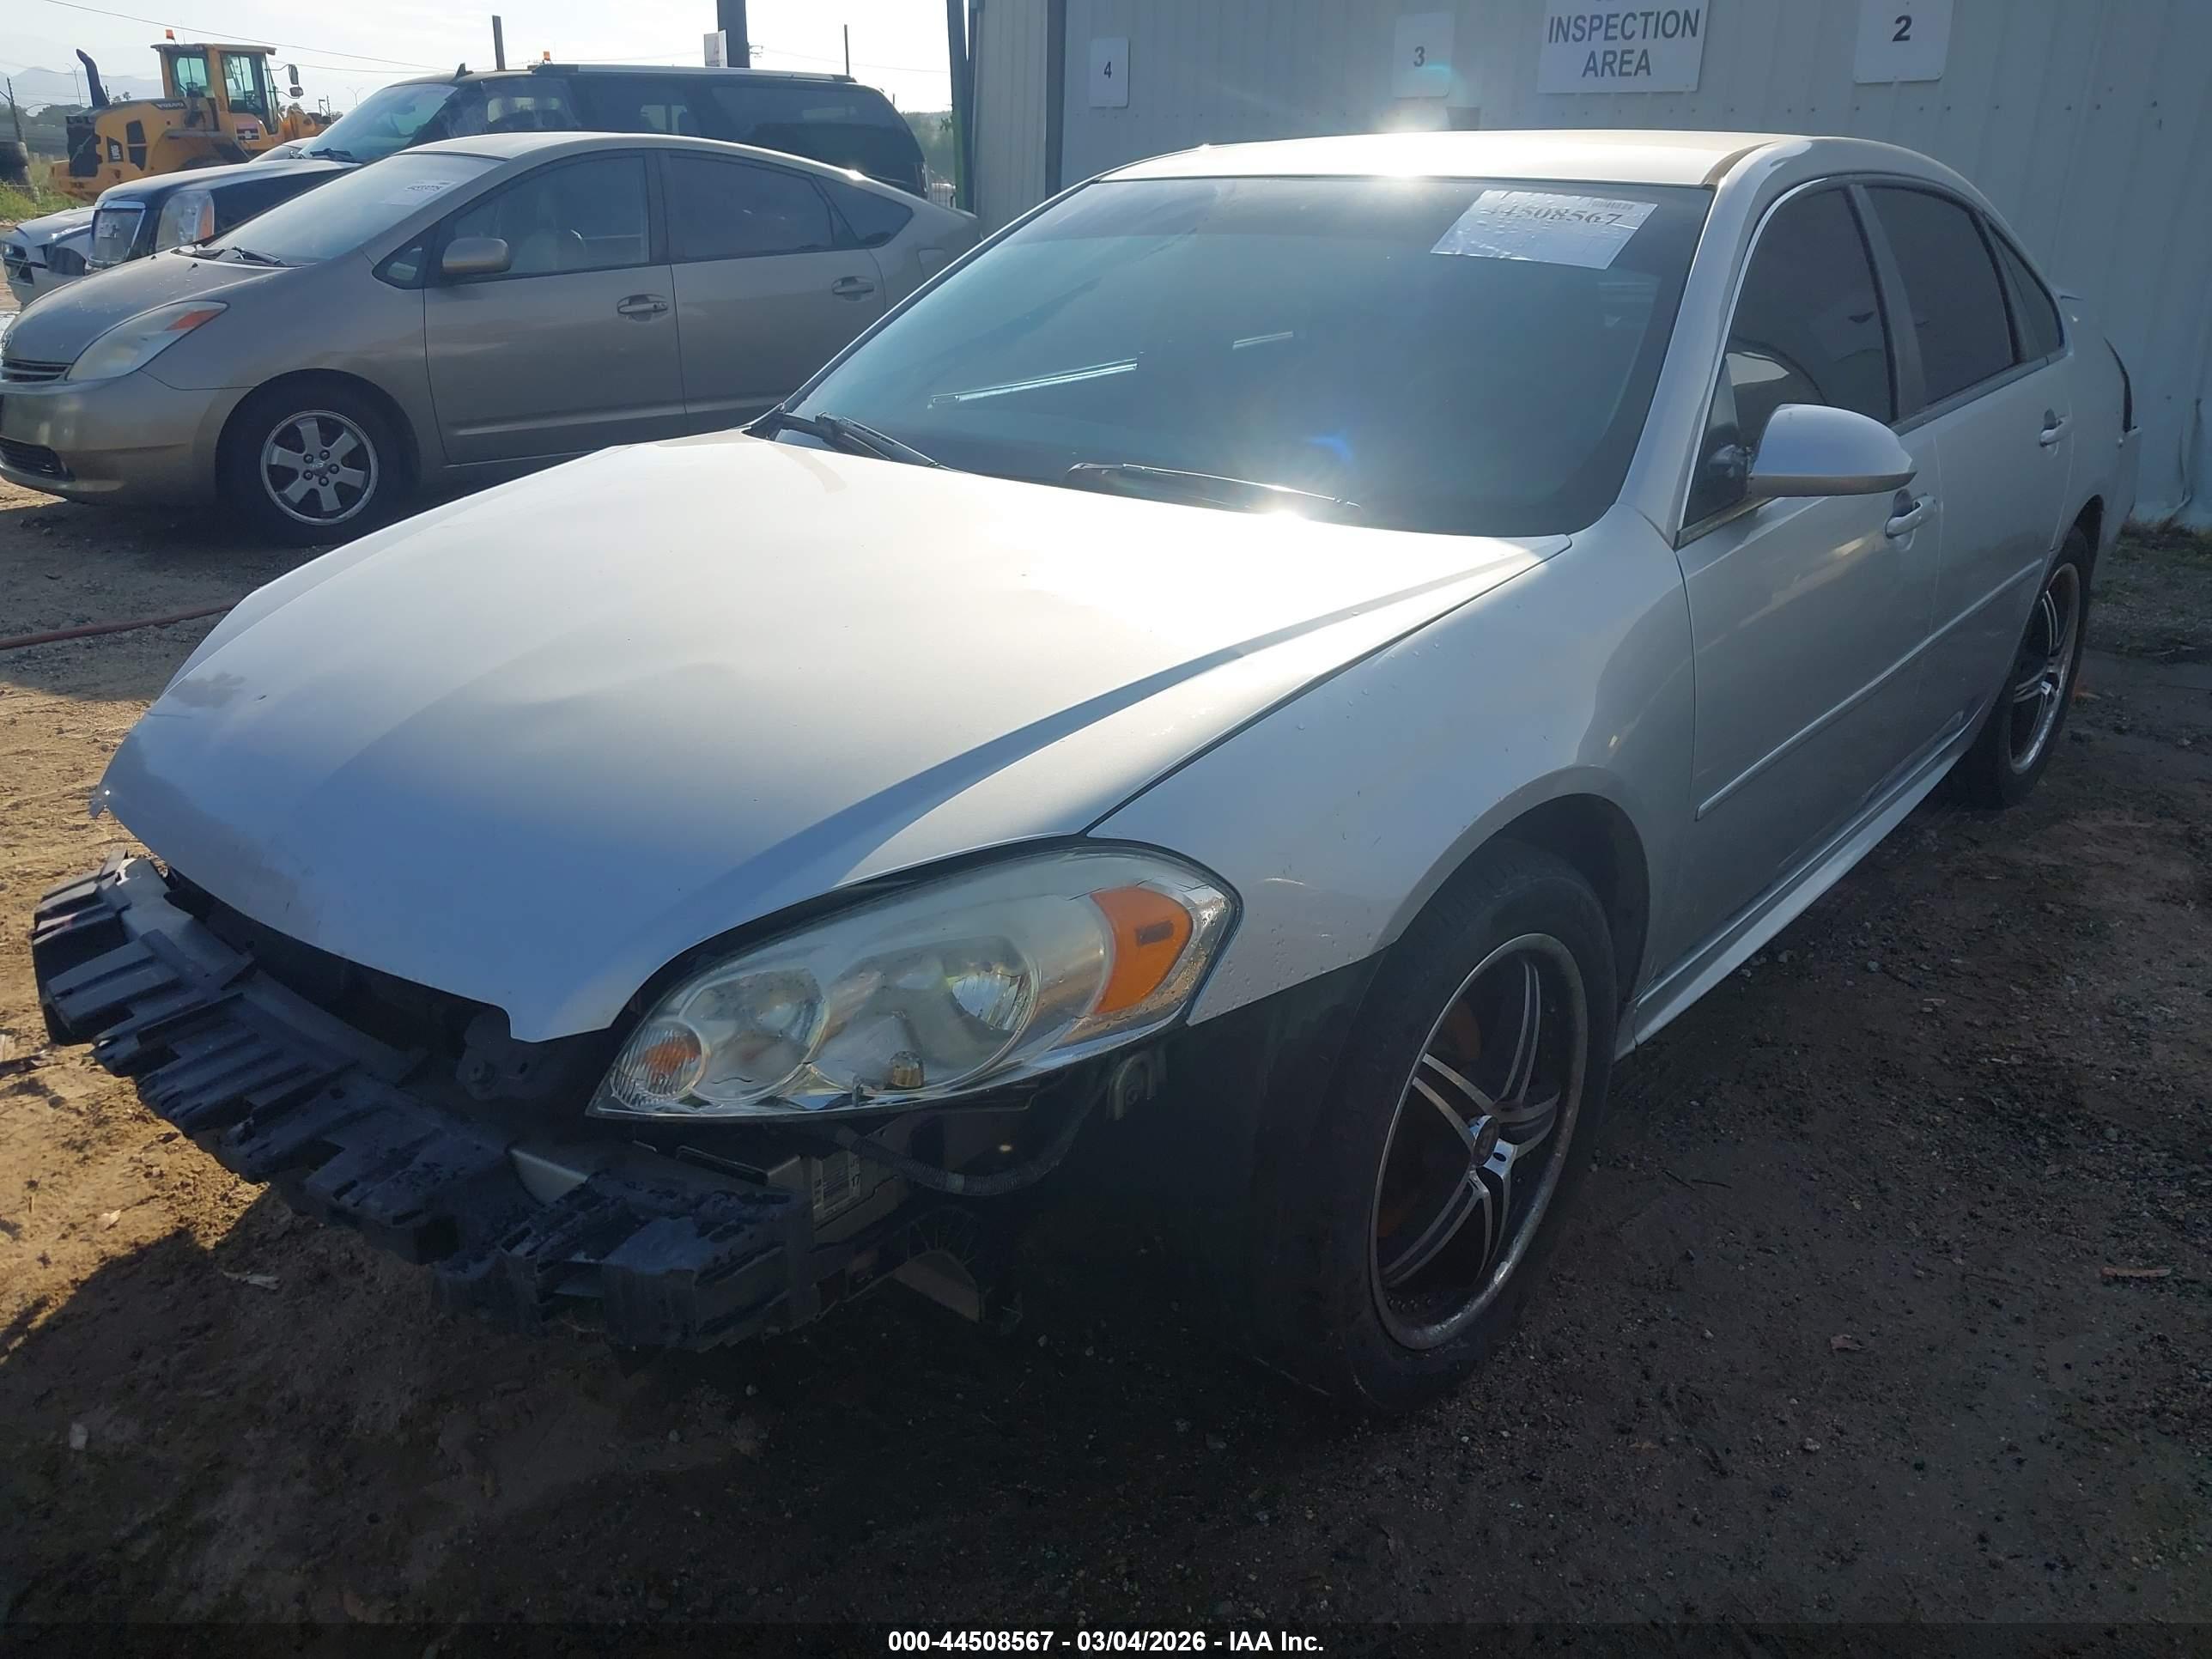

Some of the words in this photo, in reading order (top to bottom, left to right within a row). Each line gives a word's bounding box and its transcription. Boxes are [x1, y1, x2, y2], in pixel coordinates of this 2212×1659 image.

[1548, 9, 1700, 43] INSPECTION
[1892, 15, 1912, 42] 2
[1103, 61, 1113, 79] 4
[1413, 46, 1425, 67] 3
[1582, 49, 1651, 78] AREA
